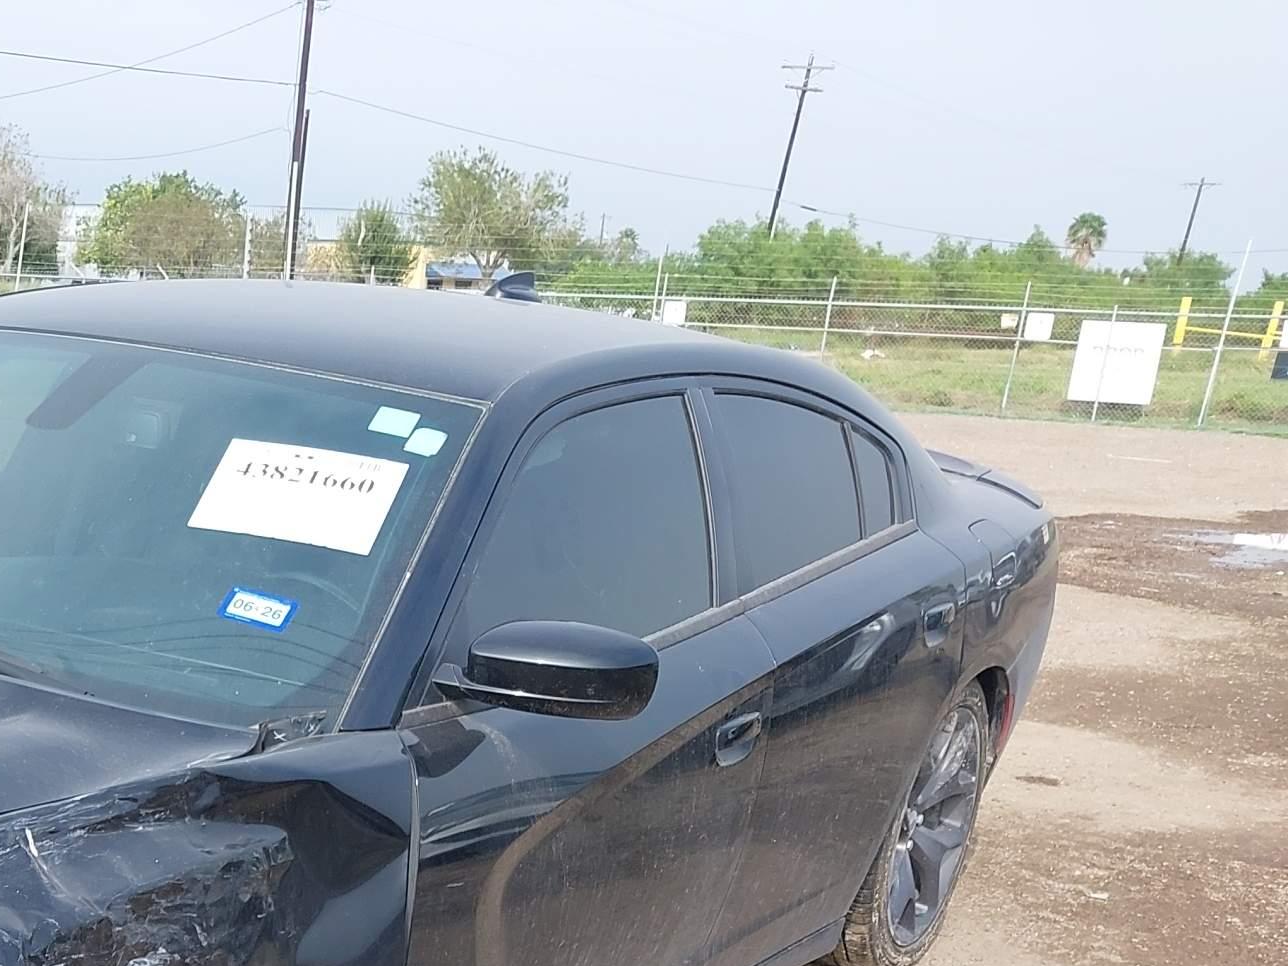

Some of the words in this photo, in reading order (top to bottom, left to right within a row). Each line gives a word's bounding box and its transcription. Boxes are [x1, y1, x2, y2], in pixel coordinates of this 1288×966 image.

[237, 461, 376, 494] 43821660
[233, 598, 254, 612] 06
[260, 606, 283, 620] 26
